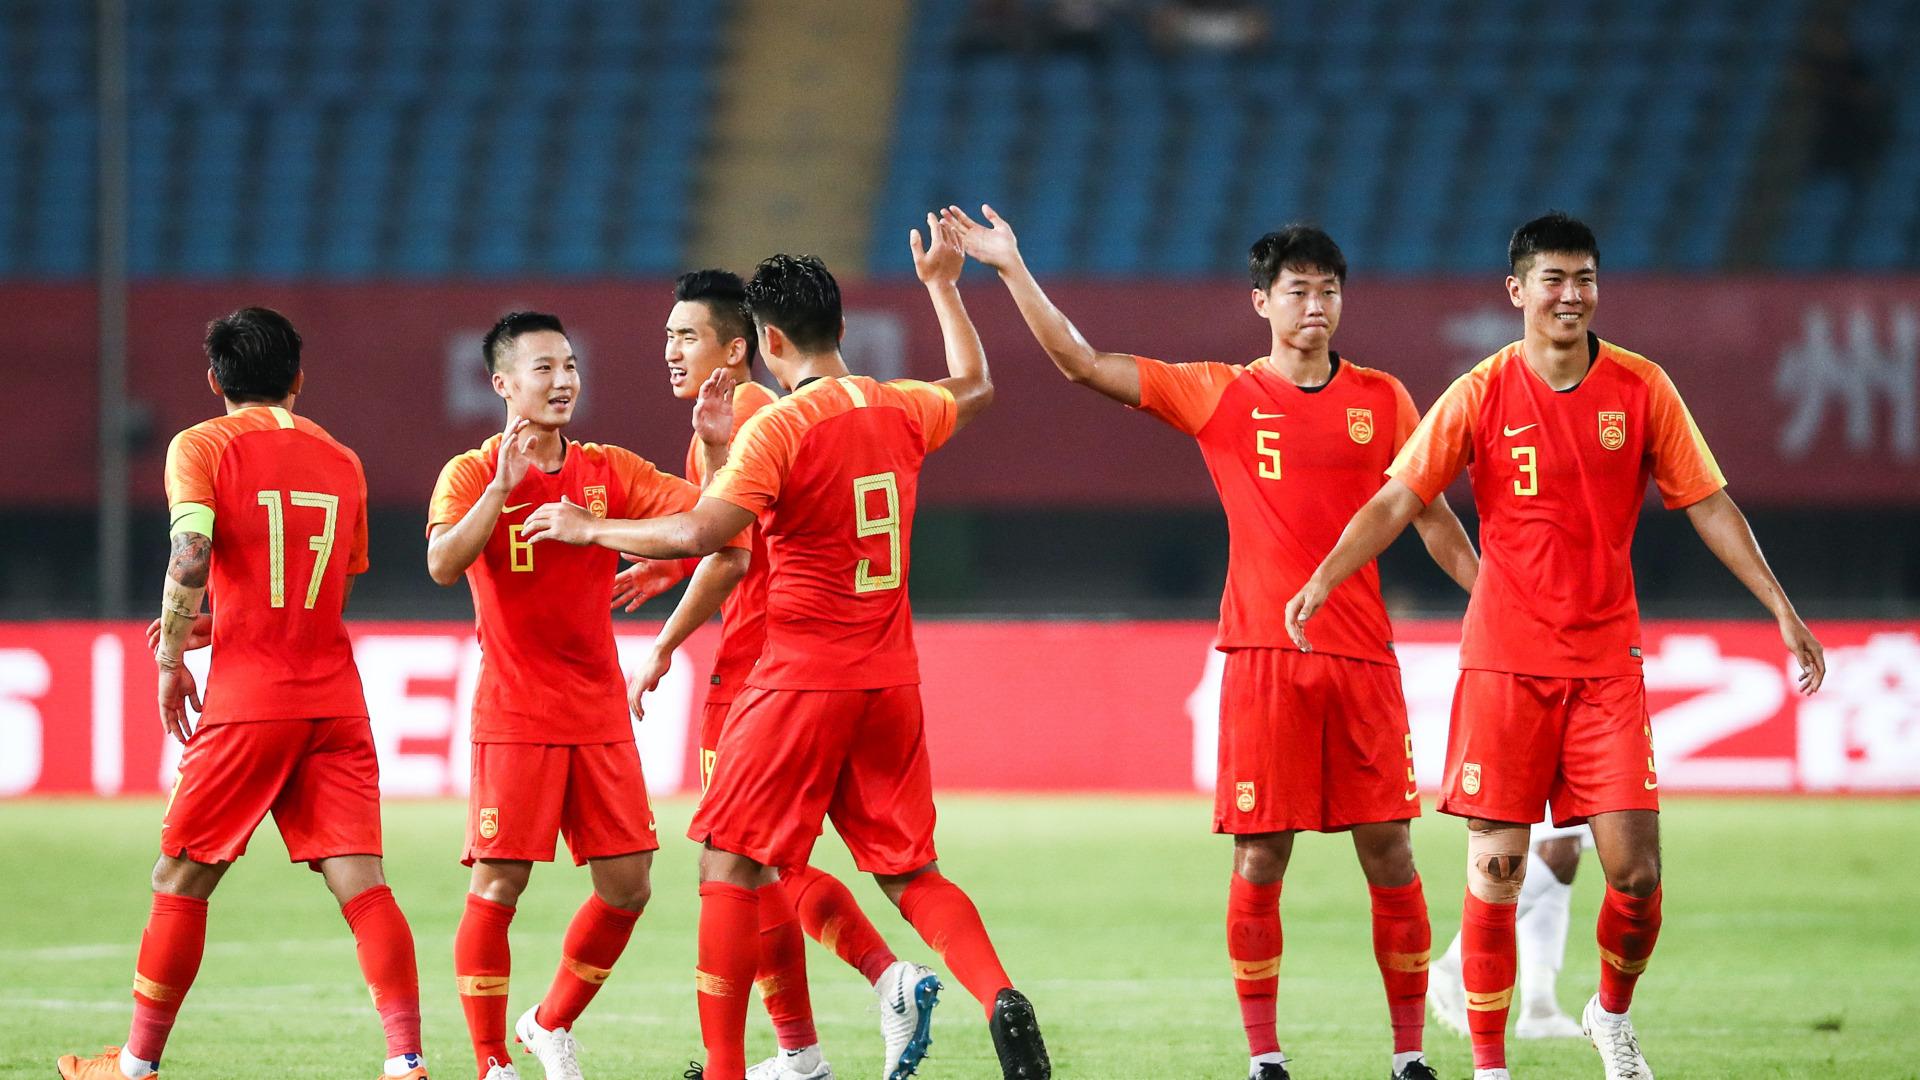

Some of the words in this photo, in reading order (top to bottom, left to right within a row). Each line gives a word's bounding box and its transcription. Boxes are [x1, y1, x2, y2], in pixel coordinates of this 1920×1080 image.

[1350, 410, 1371, 418] CFA
[1256, 430, 1281, 480] 5
[1511, 446, 1538, 496] 3
[585, 488, 605, 496] CFA
[257, 490, 339, 609] 17
[509, 524, 533, 572] 6
[854, 471, 901, 593] 9
